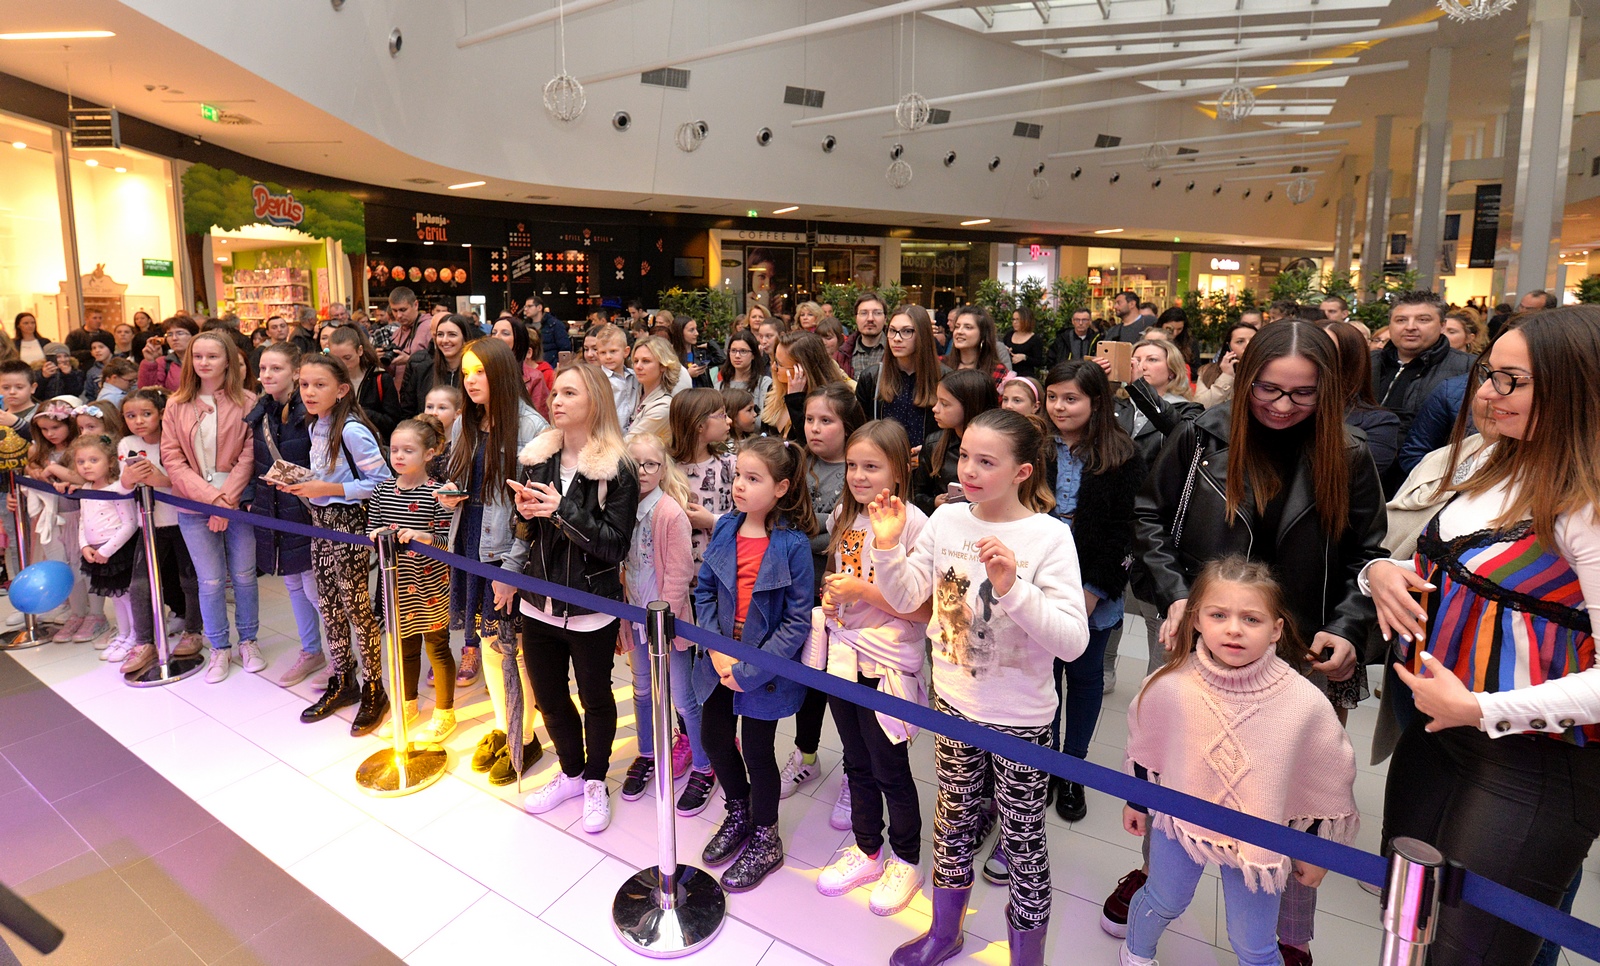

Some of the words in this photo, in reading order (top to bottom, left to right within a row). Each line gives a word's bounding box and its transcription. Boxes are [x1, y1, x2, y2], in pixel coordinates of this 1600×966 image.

[253, 186, 303, 223] Denis
[738, 230, 787, 241] COFFEE
[794, 233, 801, 241] &
[845, 235, 867, 244] BAR
[948, 550, 969, 560] WHERE
